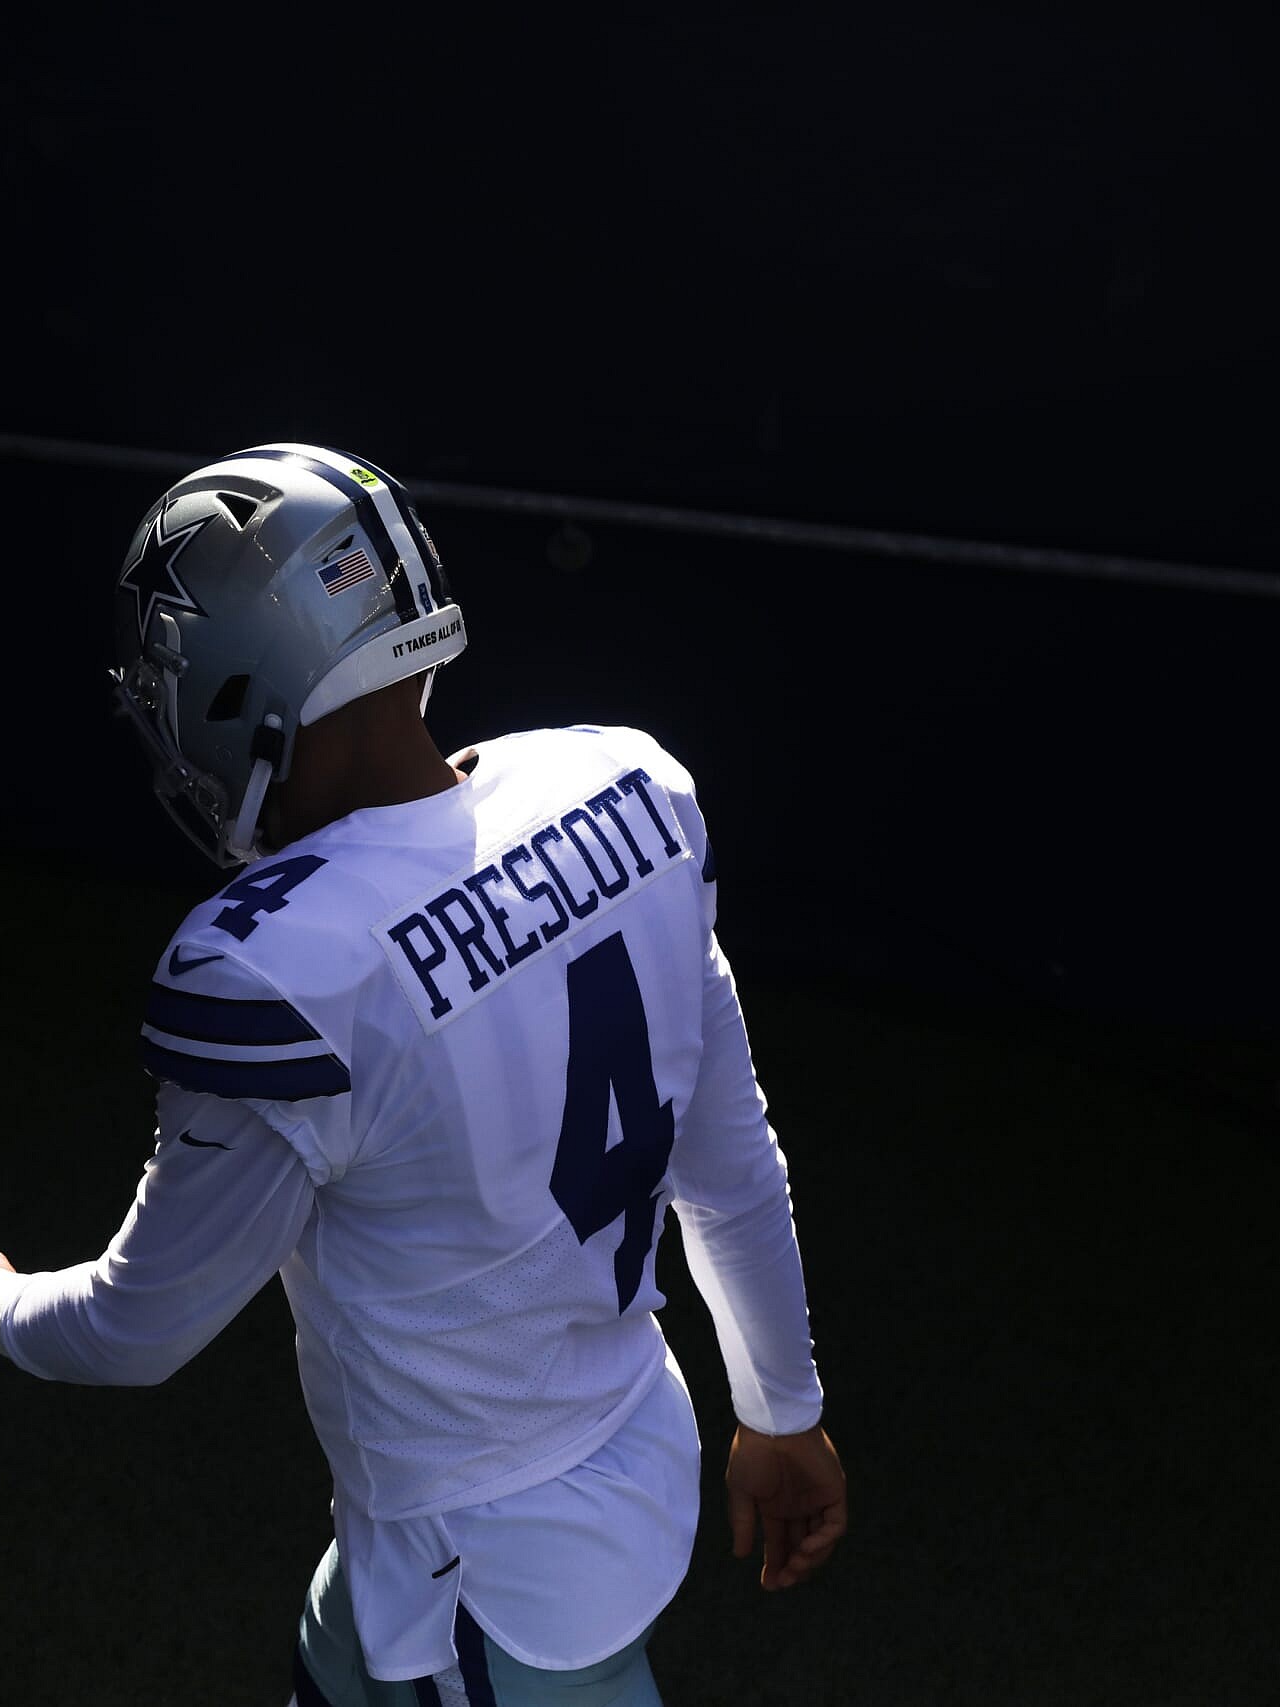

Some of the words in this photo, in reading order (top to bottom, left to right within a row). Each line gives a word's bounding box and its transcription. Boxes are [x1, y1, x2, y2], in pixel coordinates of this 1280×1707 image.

[392, 644, 404, 658] IT
[405, 631, 437, 653] TAKES
[438, 625, 451, 641] ALL
[211, 854, 329, 942] 4
[387, 768, 682, 1020] PRESCOTT
[549, 930, 676, 1316] 4
